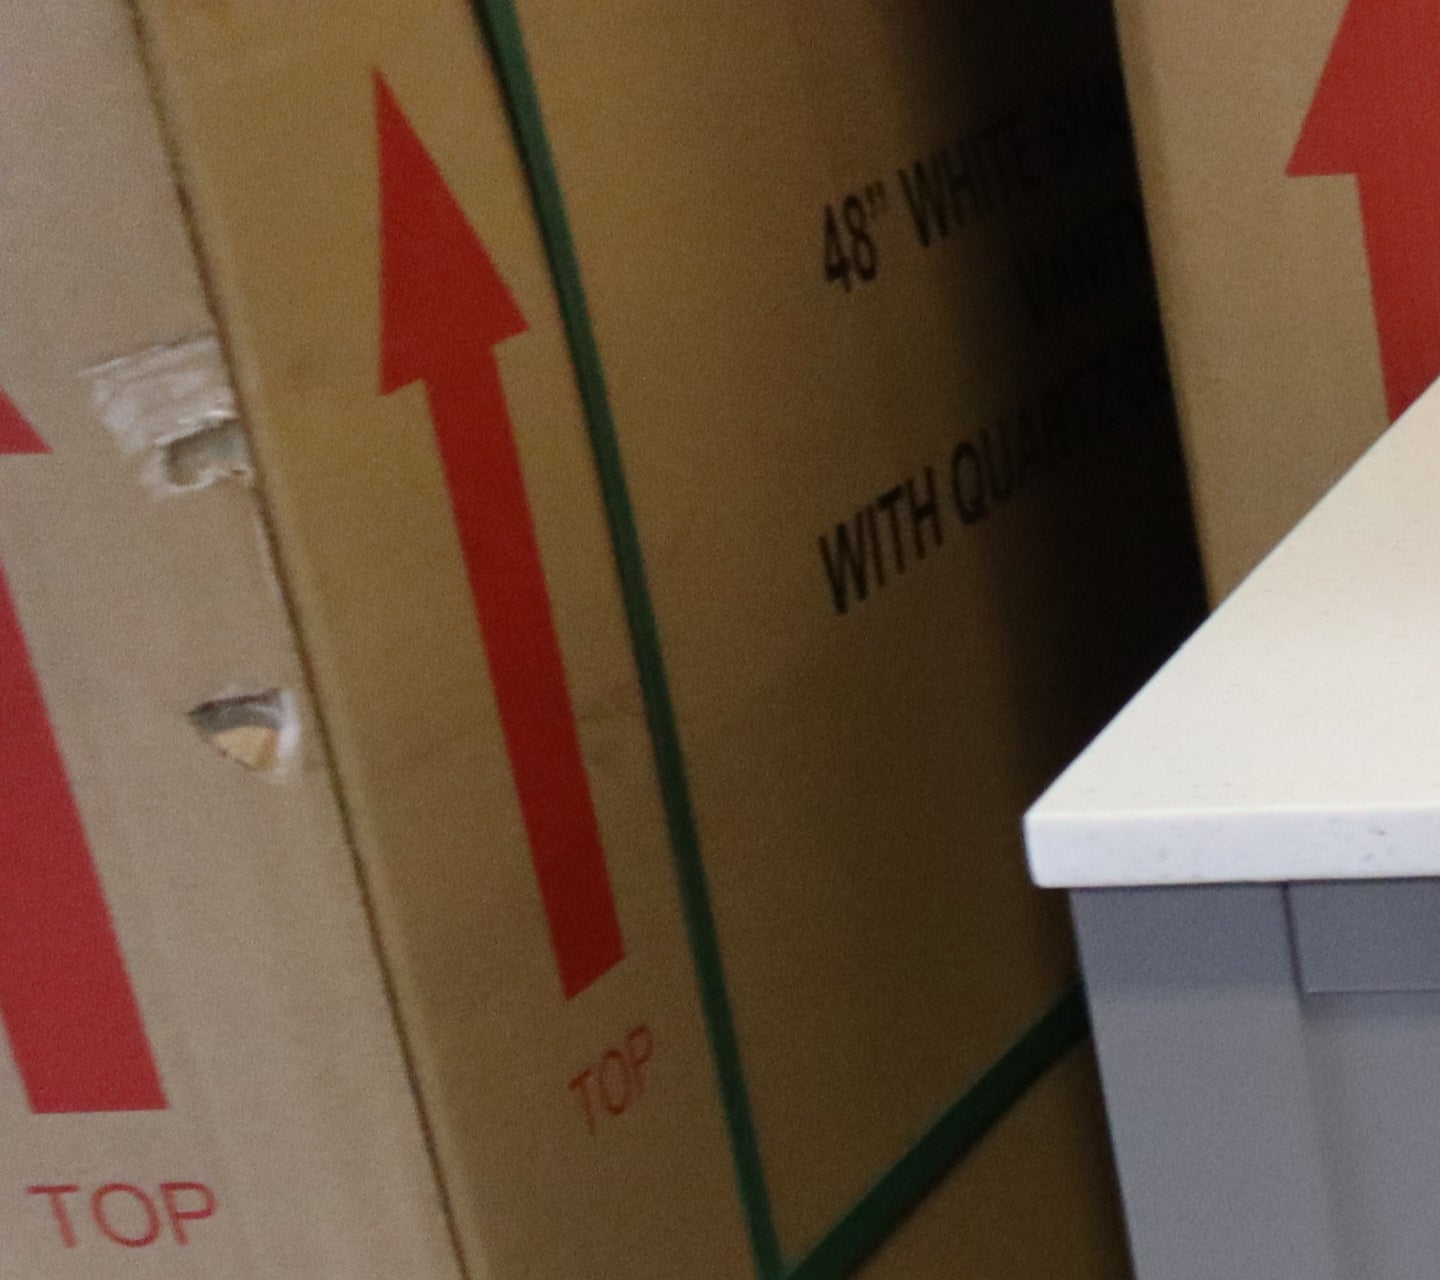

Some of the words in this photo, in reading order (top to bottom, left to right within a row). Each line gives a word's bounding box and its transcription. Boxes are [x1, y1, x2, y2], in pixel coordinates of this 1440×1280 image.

[818, 466, 944, 615] WITH
[567, 1024, 654, 1137] TOP
[27, 1181, 217, 1249] TOP
